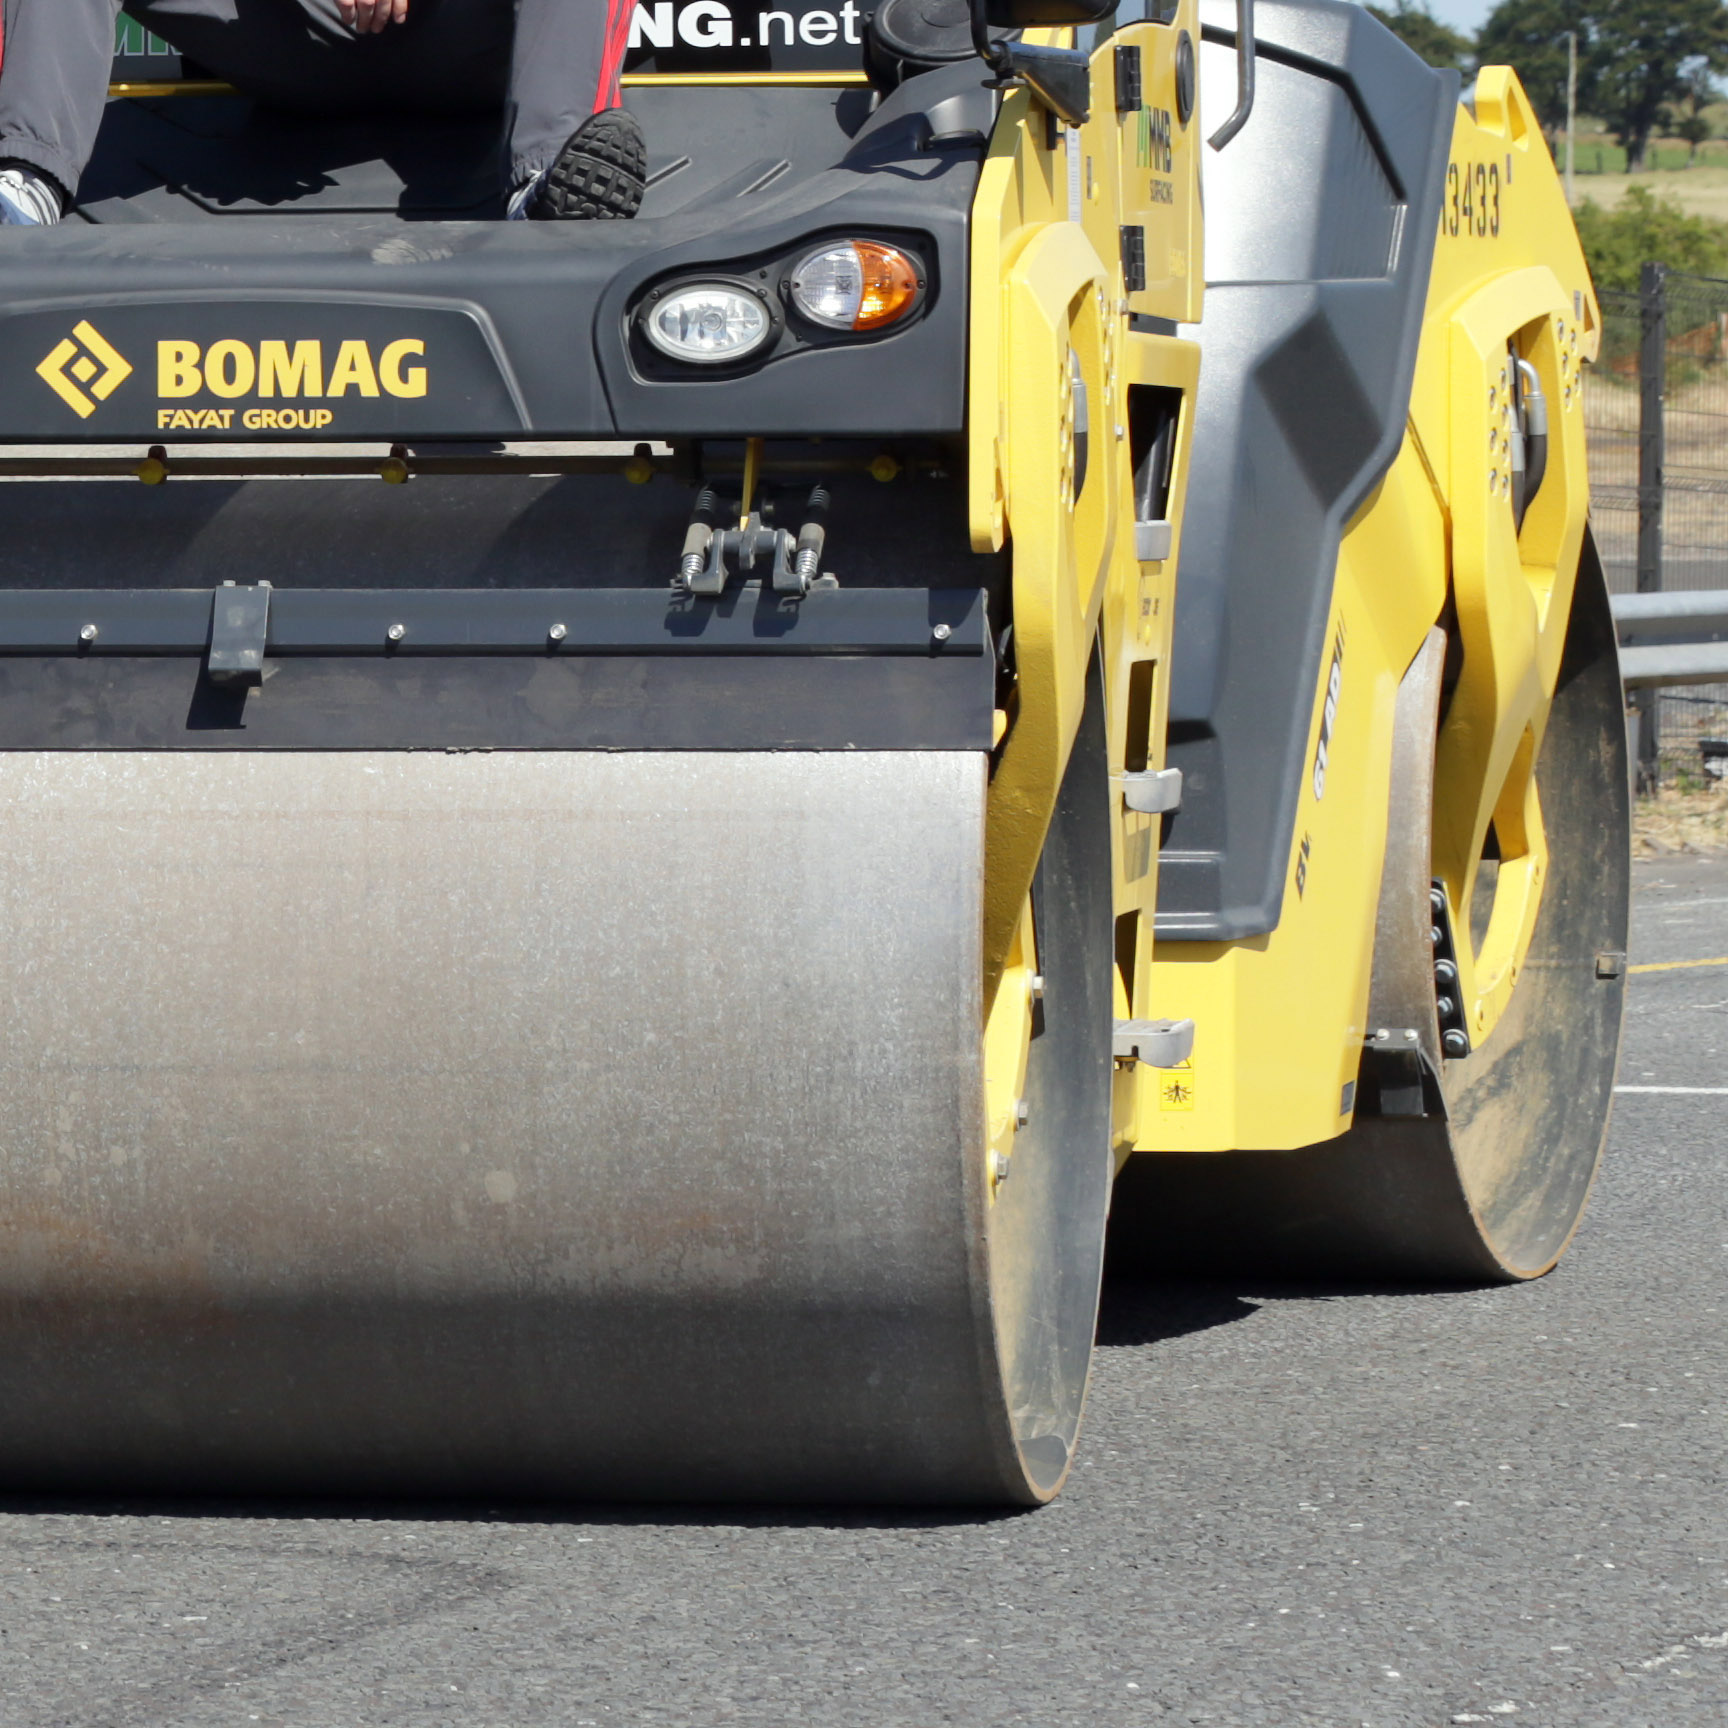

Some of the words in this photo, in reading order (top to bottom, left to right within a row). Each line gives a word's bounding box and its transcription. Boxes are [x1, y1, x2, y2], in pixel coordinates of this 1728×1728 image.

[156, 338, 428, 398] BOMAG
[156, 408, 234, 429] FAYAT
[242, 408, 333, 430] GROUP
